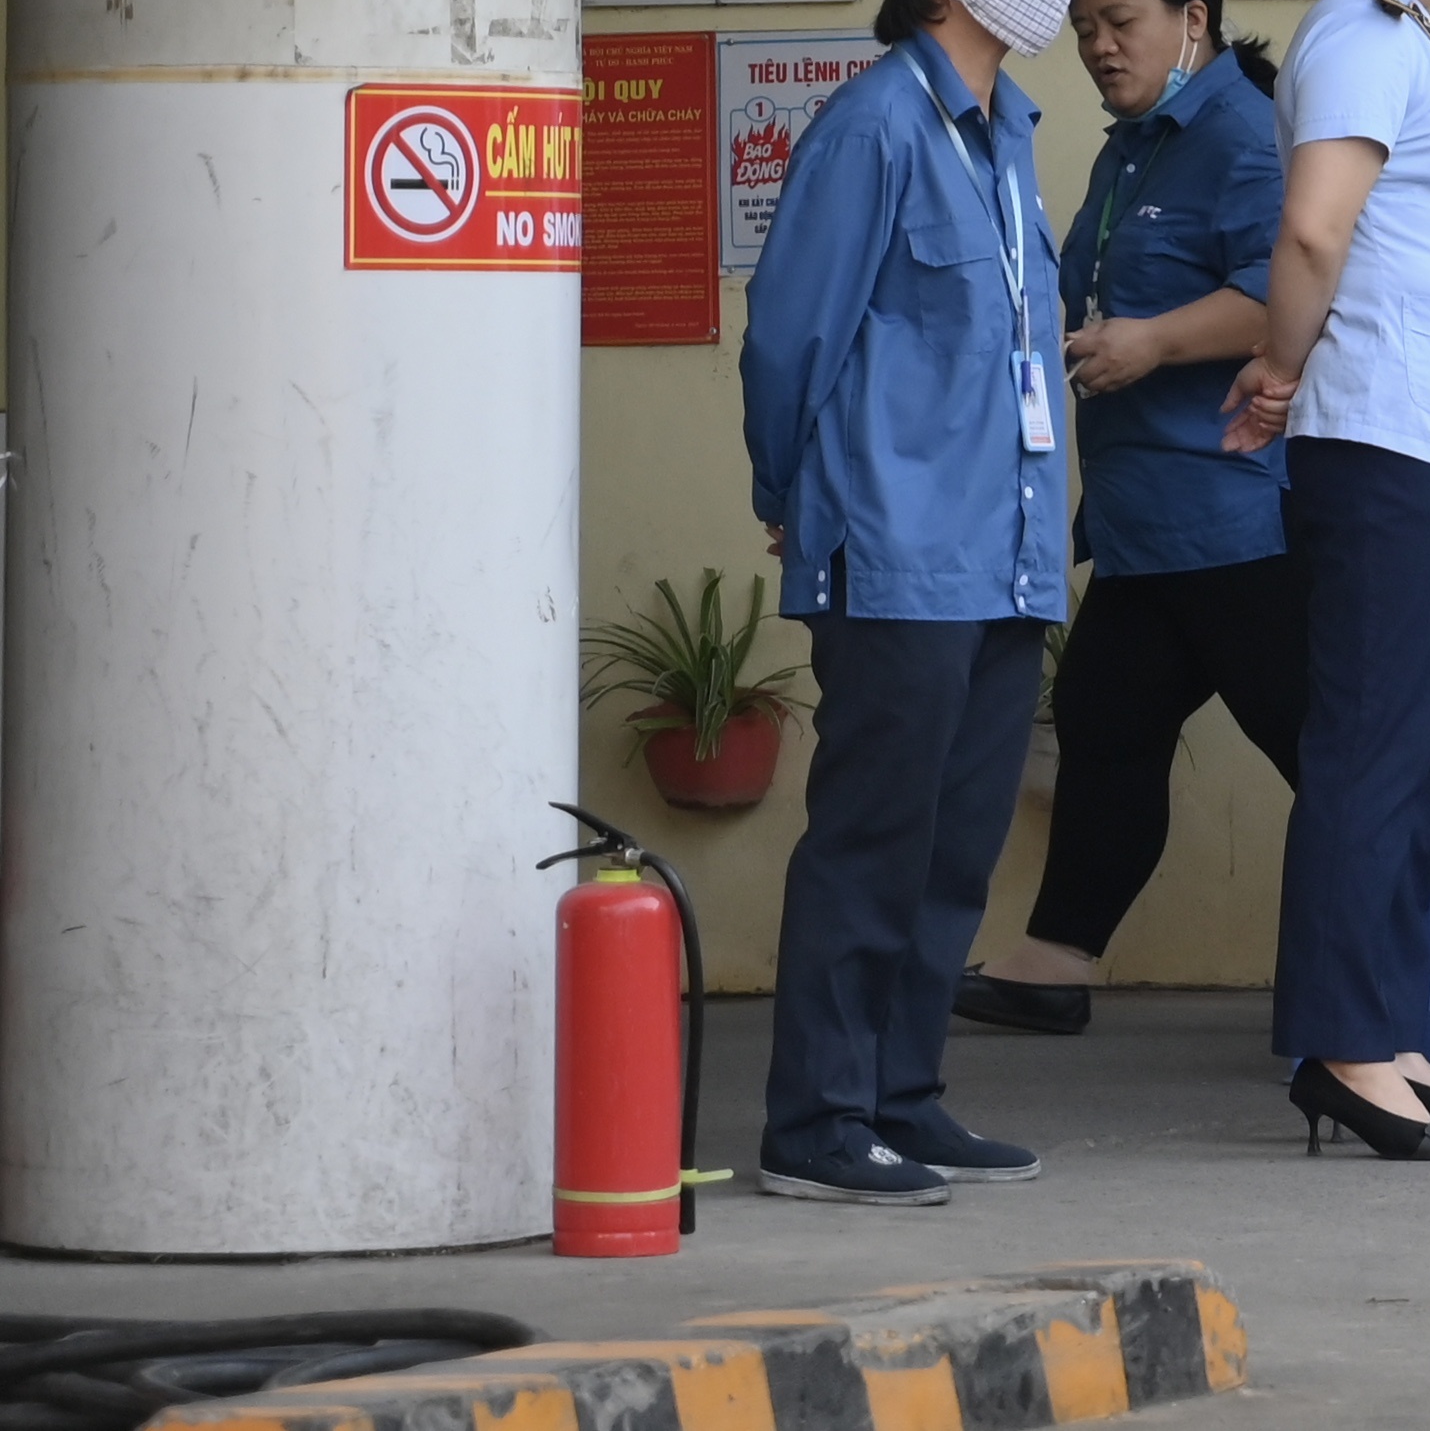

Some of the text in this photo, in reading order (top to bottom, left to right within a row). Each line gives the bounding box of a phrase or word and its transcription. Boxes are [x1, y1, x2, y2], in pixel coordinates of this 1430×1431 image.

[748, 57, 840, 87] TIÊU LỆNH
[583, 77, 663, 106] ỘI QUY
[582, 106, 702, 123] HÁY VÀ CHỮA CHÁY
[755, 102, 763, 117] 1
[486, 105, 535, 178] CẤM
[543, 112, 571, 180] HÚT
[743, 138, 772, 159] BÁO
[497, 211, 534, 246] NO
